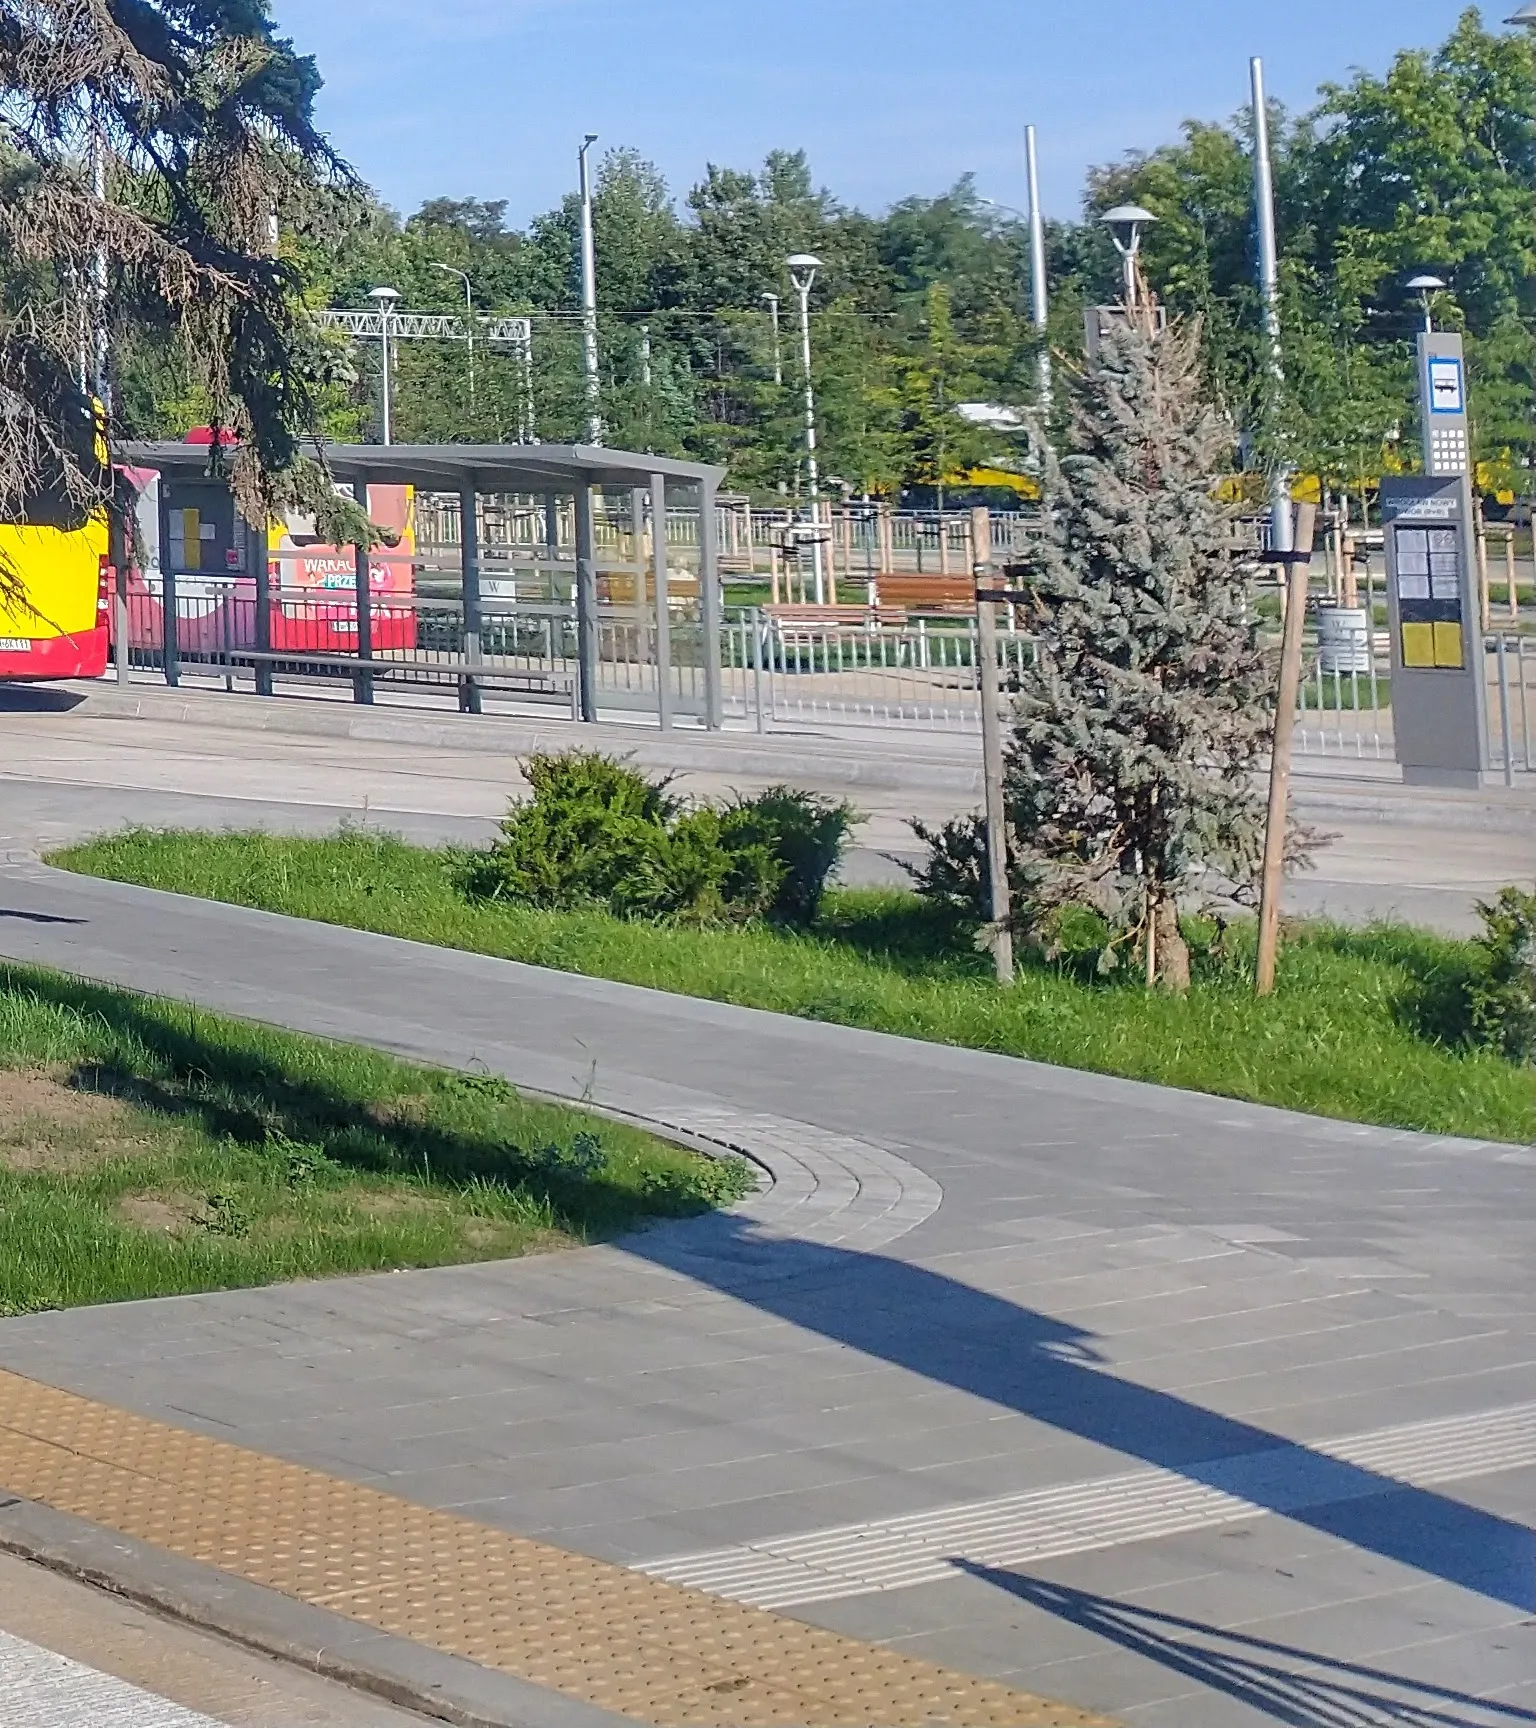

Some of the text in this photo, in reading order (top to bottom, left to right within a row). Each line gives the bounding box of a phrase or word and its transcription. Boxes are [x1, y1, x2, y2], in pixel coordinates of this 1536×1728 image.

[304, 558, 357, 573] WAKAC
[327, 574, 357, 590] PRZE
[488, 580, 500, 593] W
